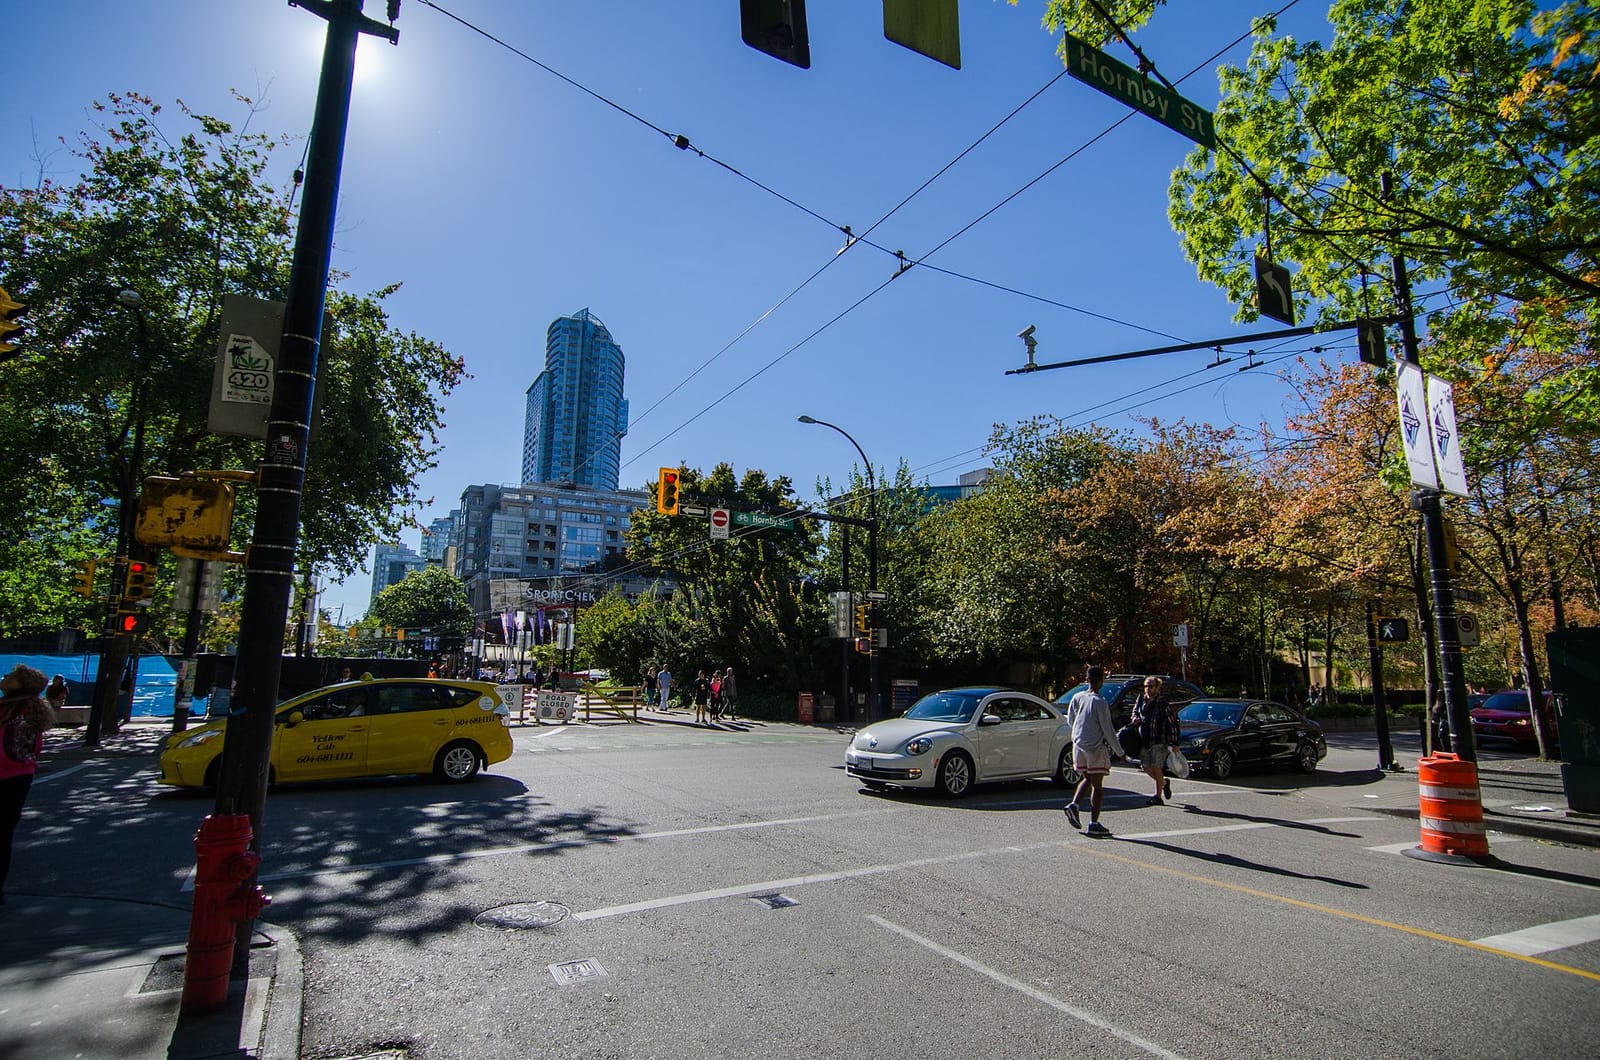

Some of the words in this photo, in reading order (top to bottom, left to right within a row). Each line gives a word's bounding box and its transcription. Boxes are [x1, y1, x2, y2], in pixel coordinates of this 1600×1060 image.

[1080, 45, 1169, 119] Hornby
[1180, 103, 1205, 137] St
[229, 371, 269, 389] 420
[752, 515, 778, 527] Hornby
[313, 735, 346, 743] Yellow
